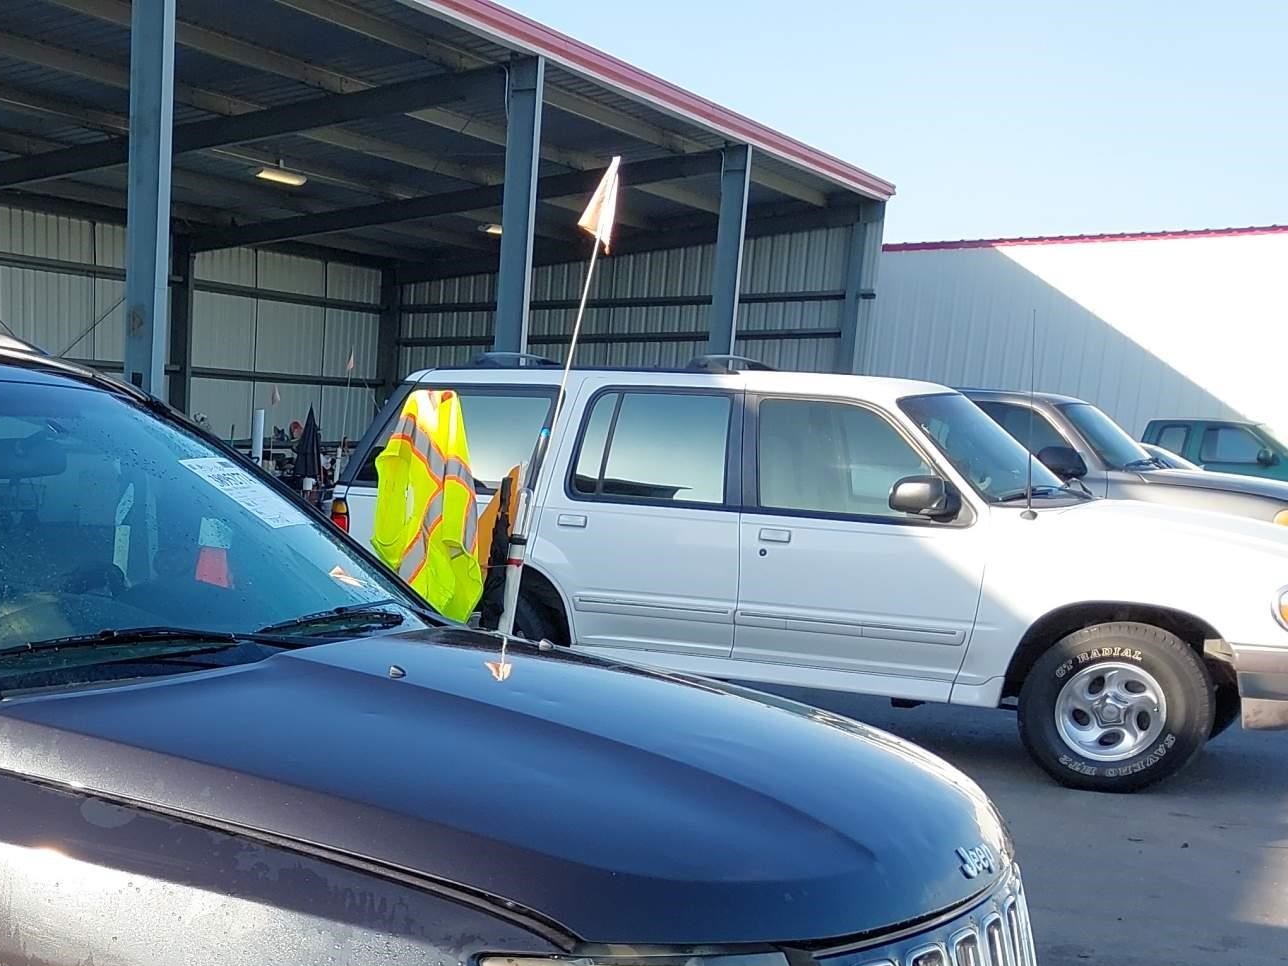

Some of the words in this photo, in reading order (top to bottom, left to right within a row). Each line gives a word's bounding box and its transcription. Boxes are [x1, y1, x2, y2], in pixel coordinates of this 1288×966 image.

[1055, 659, 1074, 679] GT
[1077, 647, 1143, 664] RADIAL
[1105, 733, 1176, 777] SAVERO
[953, 843, 995, 880] Jeep
